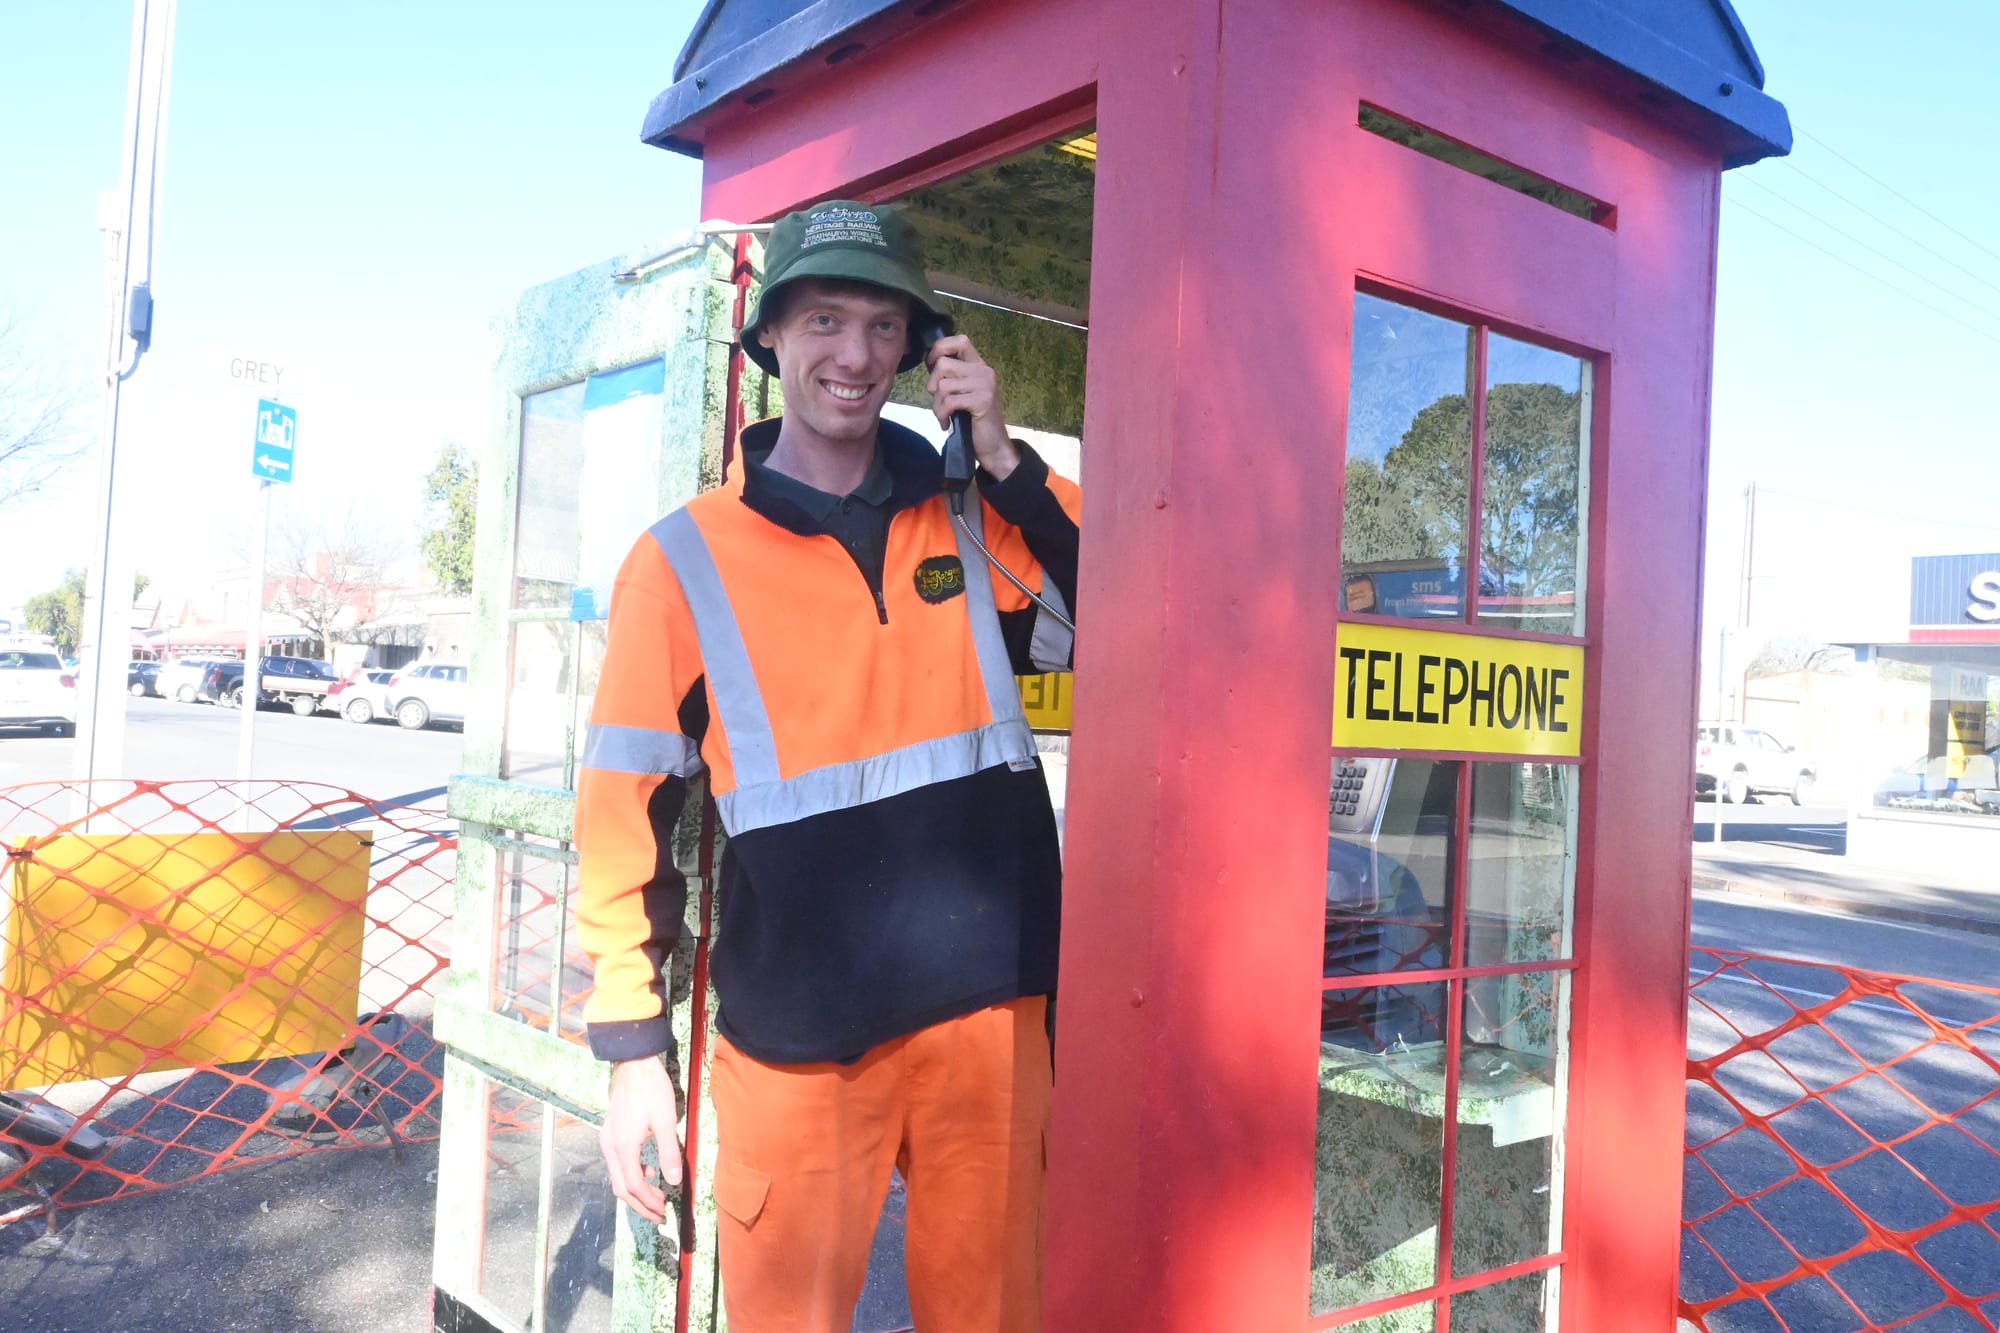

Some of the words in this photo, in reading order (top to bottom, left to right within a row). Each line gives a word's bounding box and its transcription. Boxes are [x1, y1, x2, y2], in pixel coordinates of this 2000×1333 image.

[805, 222, 845, 234] HERITAGE
[847, 222, 881, 232] RAILWAY
[230, 357, 284, 385] GREY
[1411, 581, 1442, 594] sms
[1340, 646, 1570, 733] TELEPHONE
